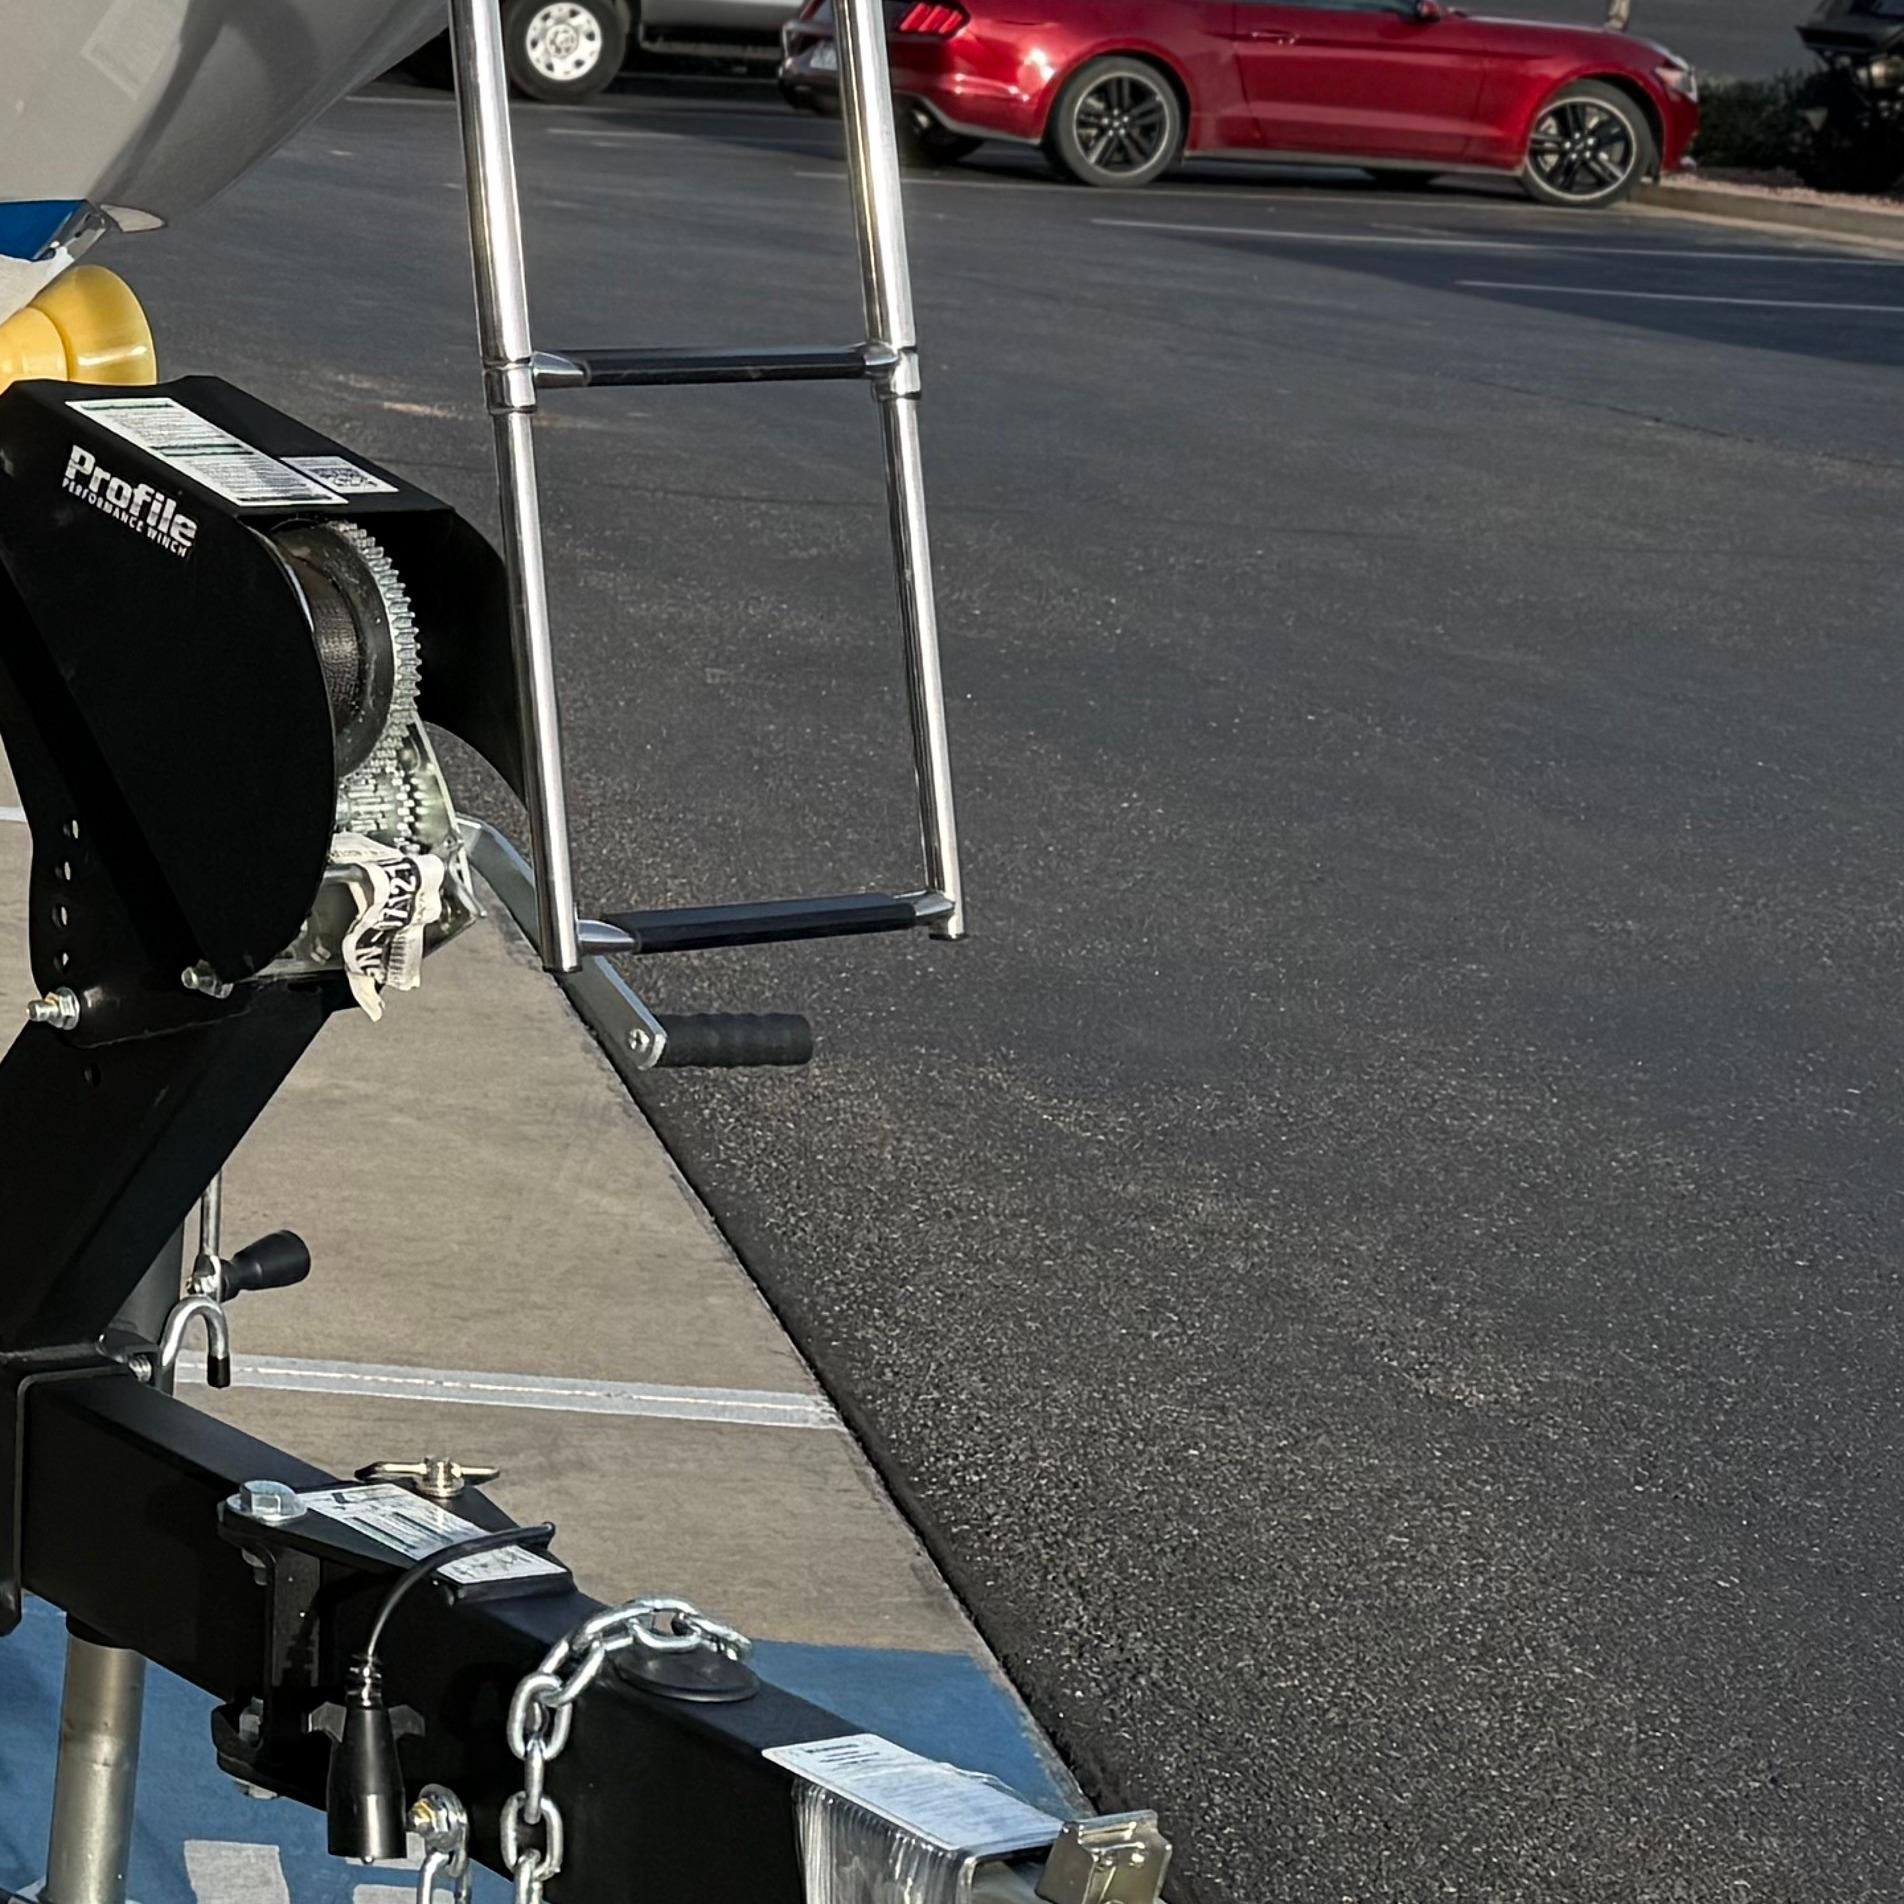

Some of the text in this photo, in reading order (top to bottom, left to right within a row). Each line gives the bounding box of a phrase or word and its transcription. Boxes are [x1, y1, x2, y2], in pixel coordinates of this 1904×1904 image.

[61, 477, 188, 558] PERFORMANCE WINCH
[64, 444, 197, 547] Profile
